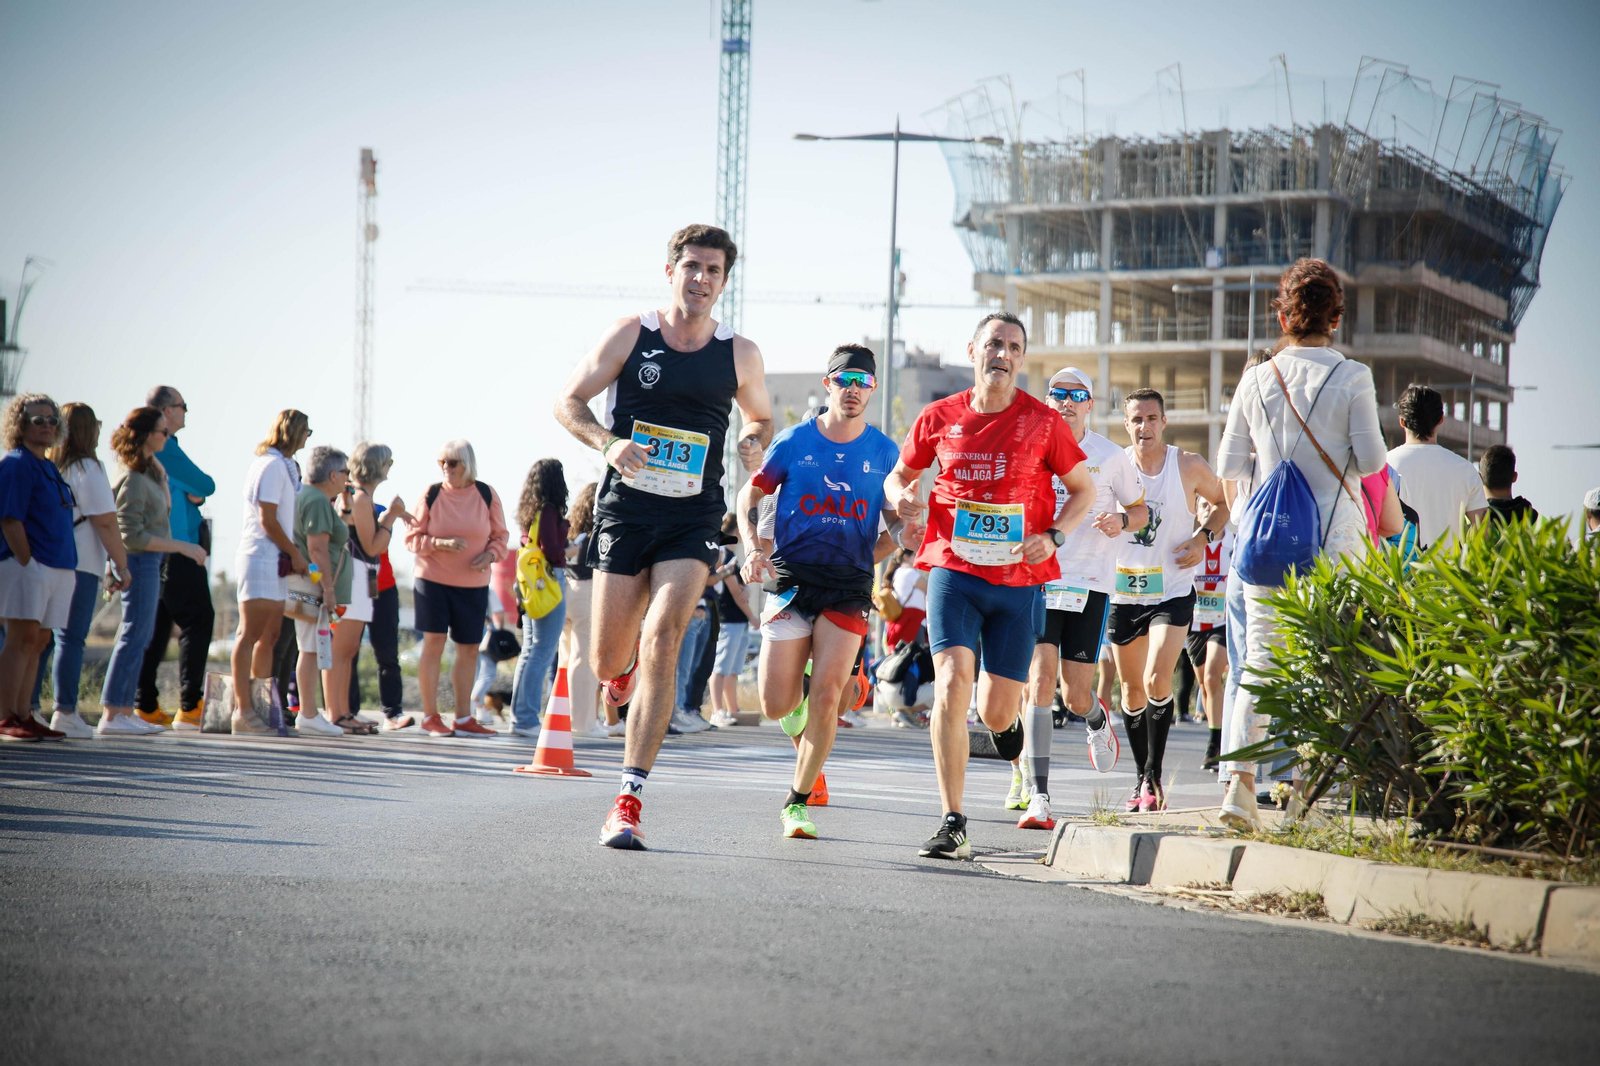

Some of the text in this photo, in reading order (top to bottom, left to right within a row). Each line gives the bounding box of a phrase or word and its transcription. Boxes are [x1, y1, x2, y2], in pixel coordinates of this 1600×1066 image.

[647, 437, 691, 463] 813
[953, 452, 992, 461] GENERALI
[647, 457, 666, 467] IGUEL
[954, 467, 992, 481] MÁLAGA
[800, 494, 868, 520] GALO
[822, 517, 846, 526] SPORT
[968, 512, 1010, 534] 793
[1127, 575, 1148, 588] 25
